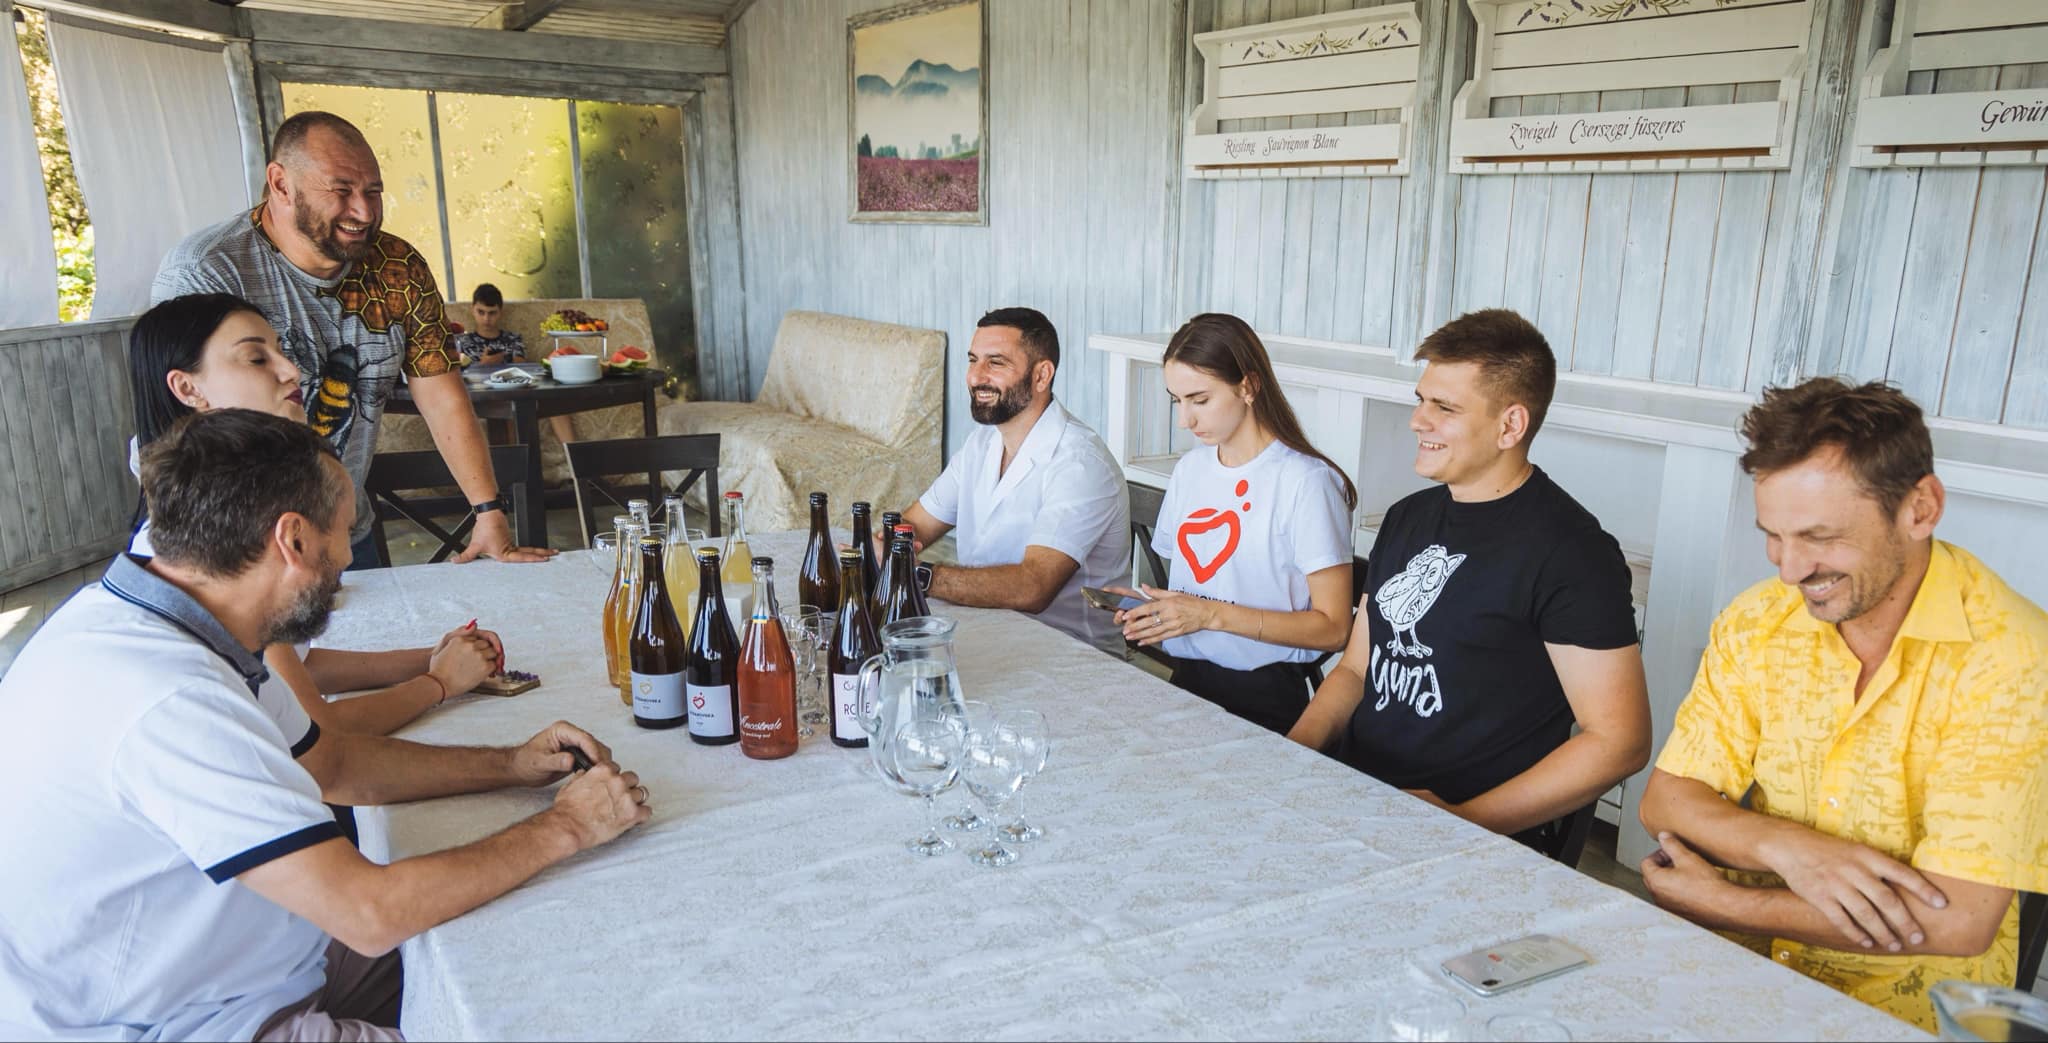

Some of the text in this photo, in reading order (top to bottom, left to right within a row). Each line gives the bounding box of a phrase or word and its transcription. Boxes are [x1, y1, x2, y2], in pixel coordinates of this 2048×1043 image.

[1224, 133, 1340, 158] Riesling Sauvignon Blanc
[1510, 121, 1558, 150] Zweigelt
[1569, 116, 1631, 144] Cserszegi
